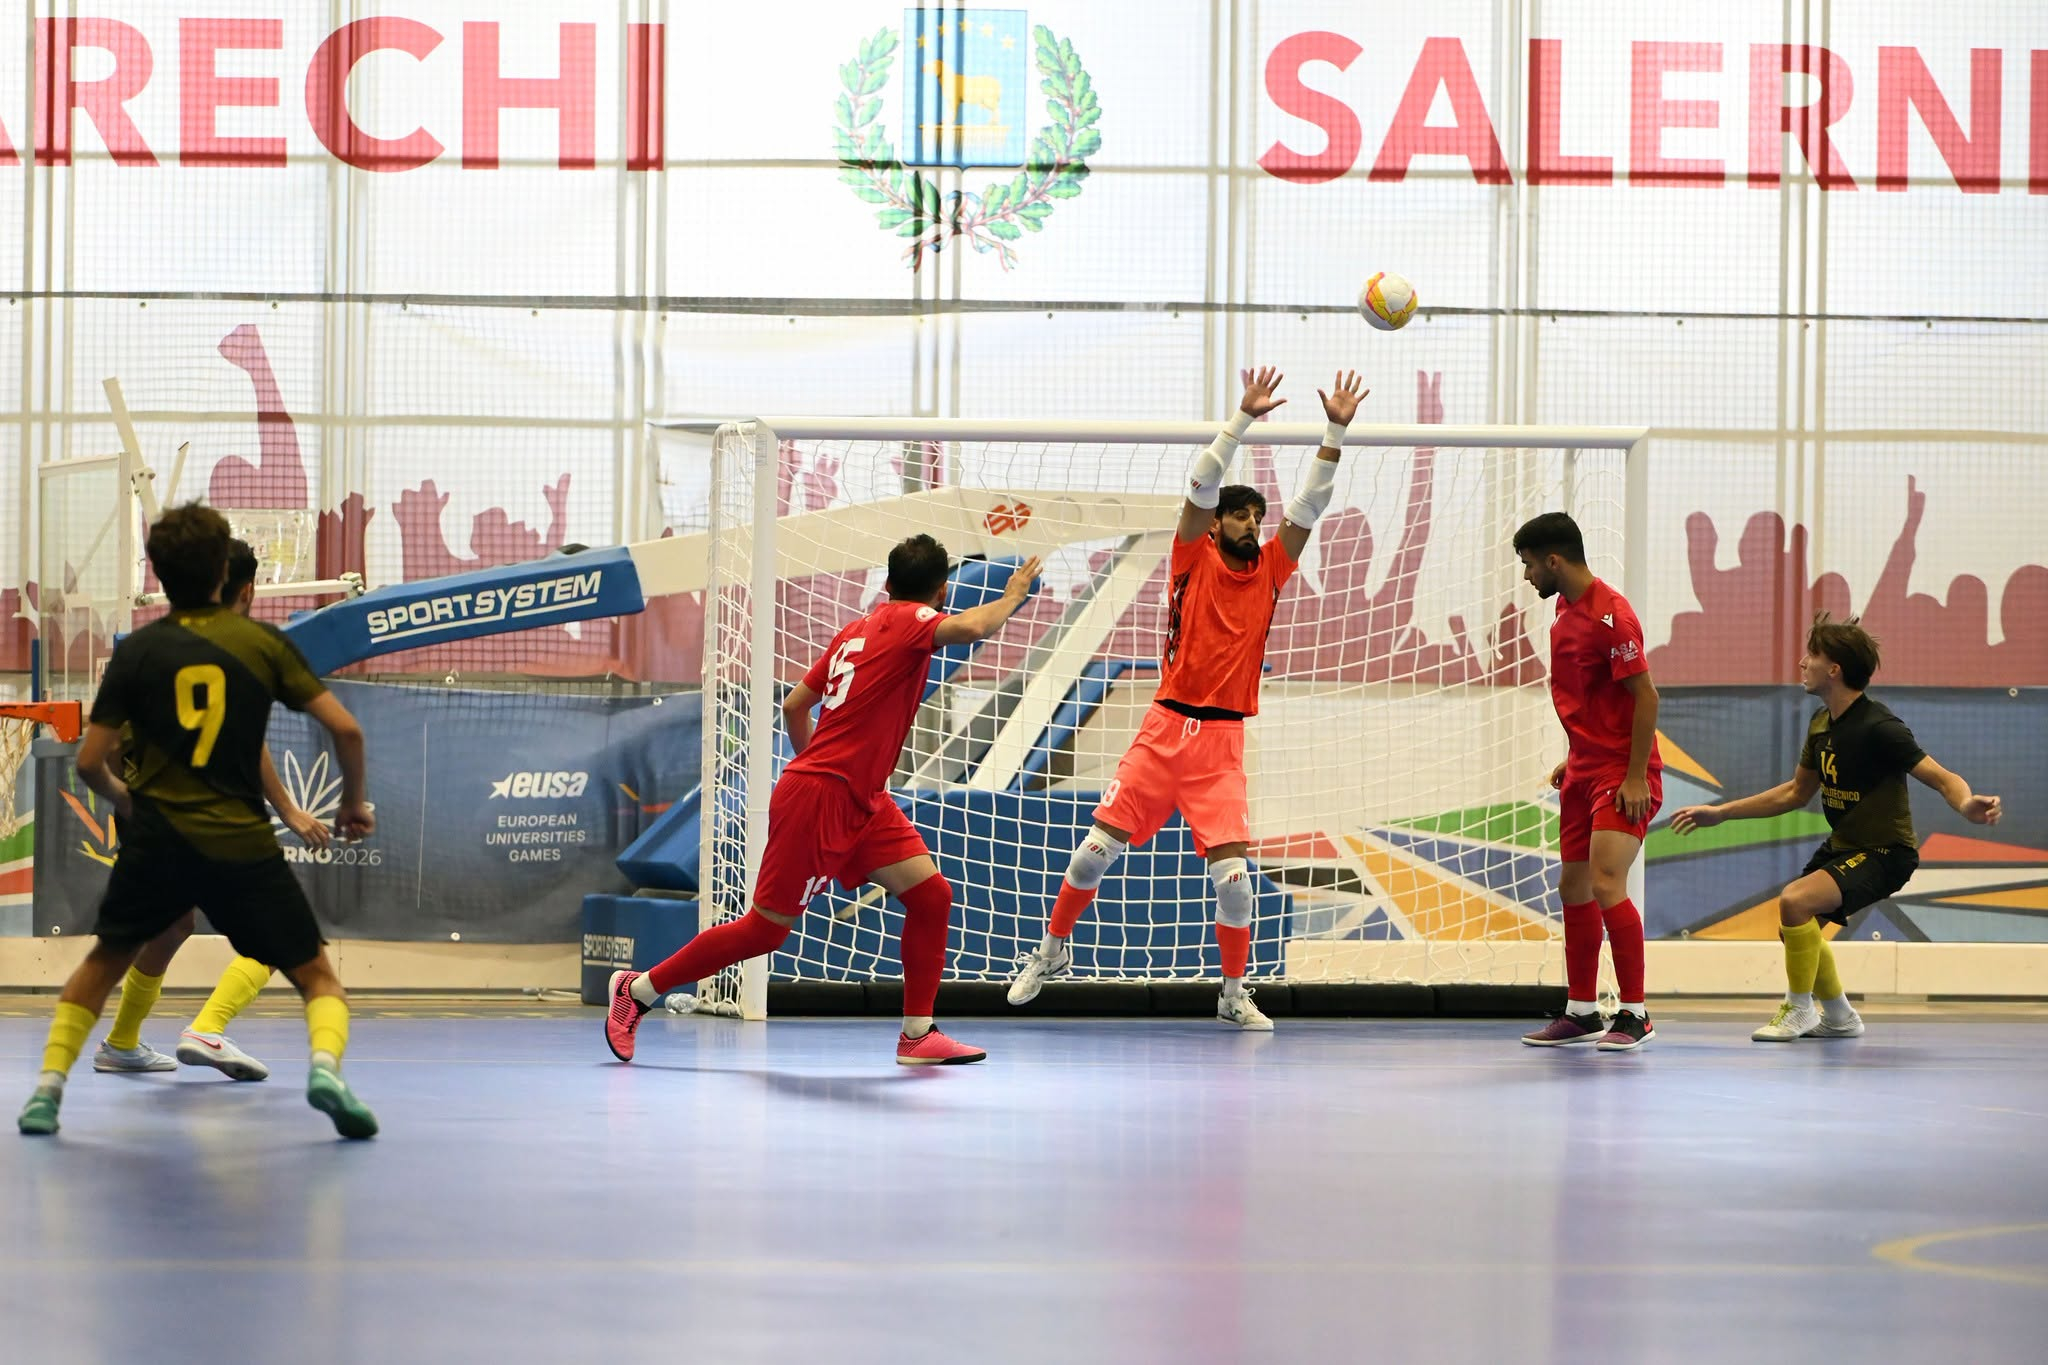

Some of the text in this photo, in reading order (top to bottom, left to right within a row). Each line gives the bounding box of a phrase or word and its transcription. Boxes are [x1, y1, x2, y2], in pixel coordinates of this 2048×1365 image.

[0, 16, 665, 173] RECHI
[175, 663, 226, 768] 9
[1820, 751, 1838, 785] 14
[511, 771, 589, 798] eusa
[497, 814, 577, 828] EUROPEAN
[486, 830, 586, 845] UNIVERSITIES
[283, 845, 382, 866] RNO2026
[509, 848, 561, 863] GAMES
